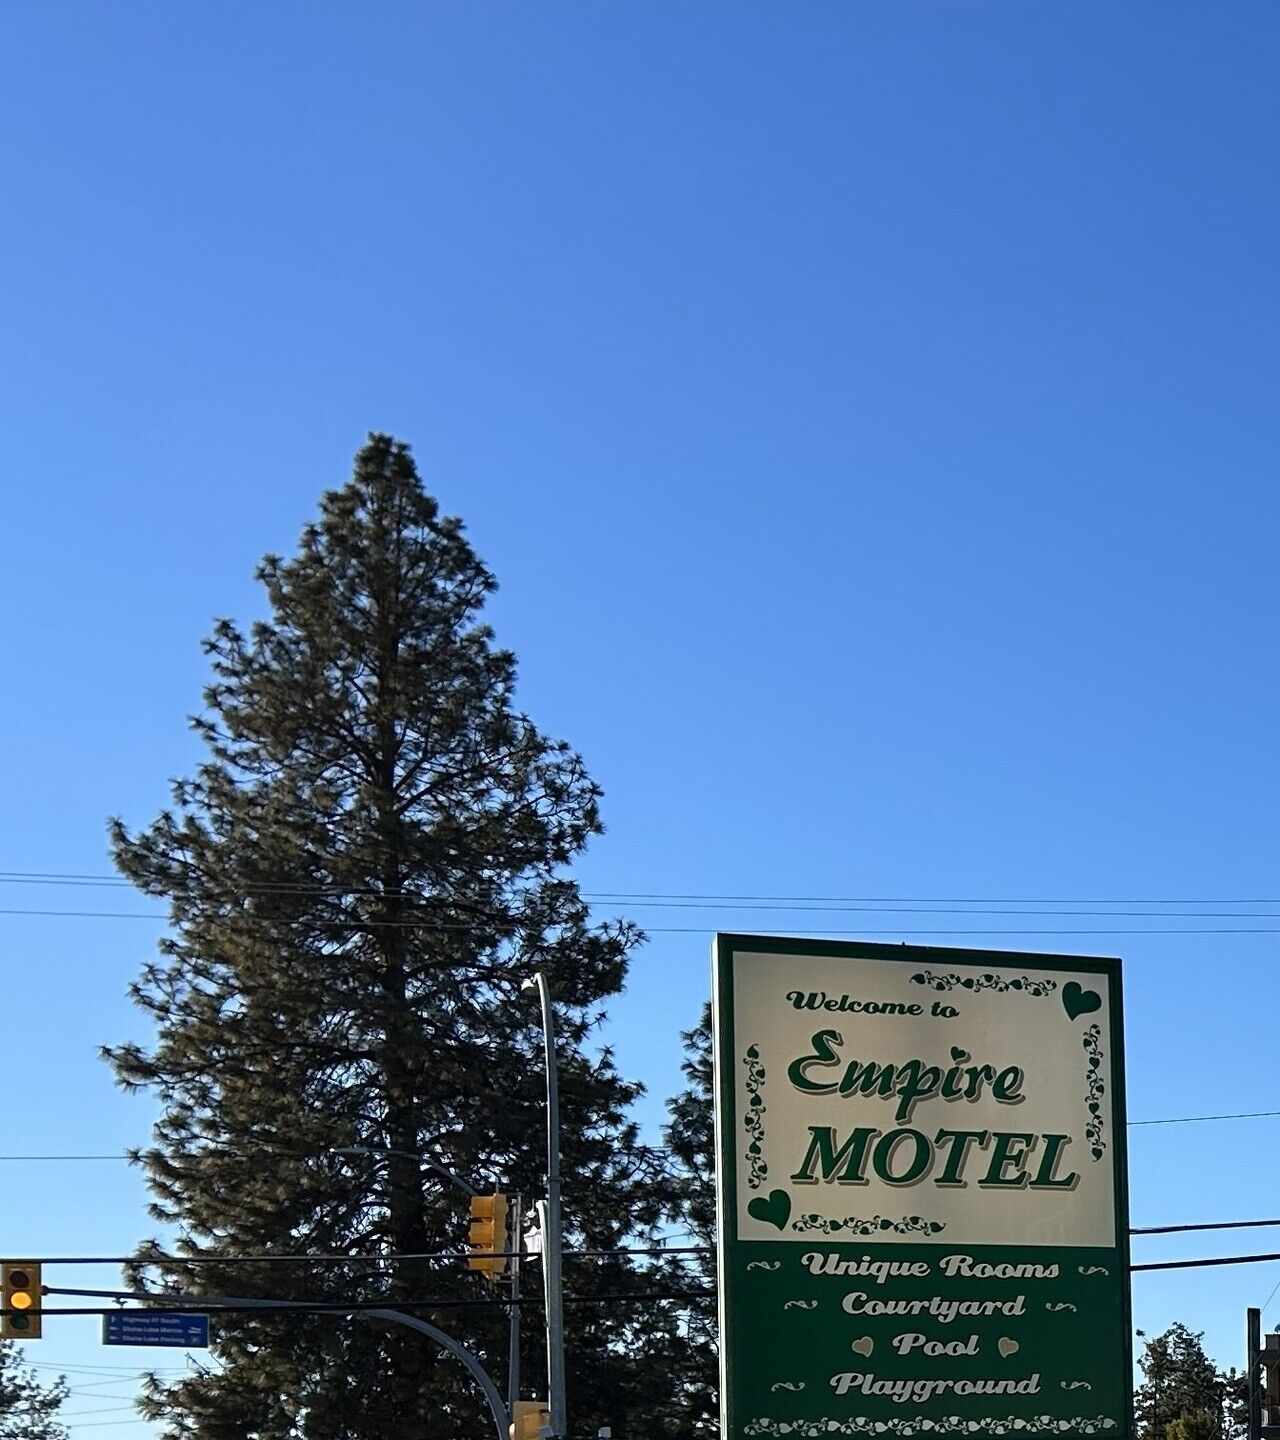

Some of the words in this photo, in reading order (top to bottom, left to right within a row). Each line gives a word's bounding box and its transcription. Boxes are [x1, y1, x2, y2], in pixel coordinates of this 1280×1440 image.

[786, 990, 924, 1017] Welcome
[931, 1002, 960, 1018] to
[787, 1028, 1026, 1125] Empire
[790, 1125, 1081, 1192] MOTEL
[800, 1251, 930, 1284] Unique
[938, 1254, 1060, 1279] Rooms
[841, 1291, 1026, 1323] Courtyard
[892, 1333, 980, 1357] Pool
[829, 1372, 1041, 1402] Playground
